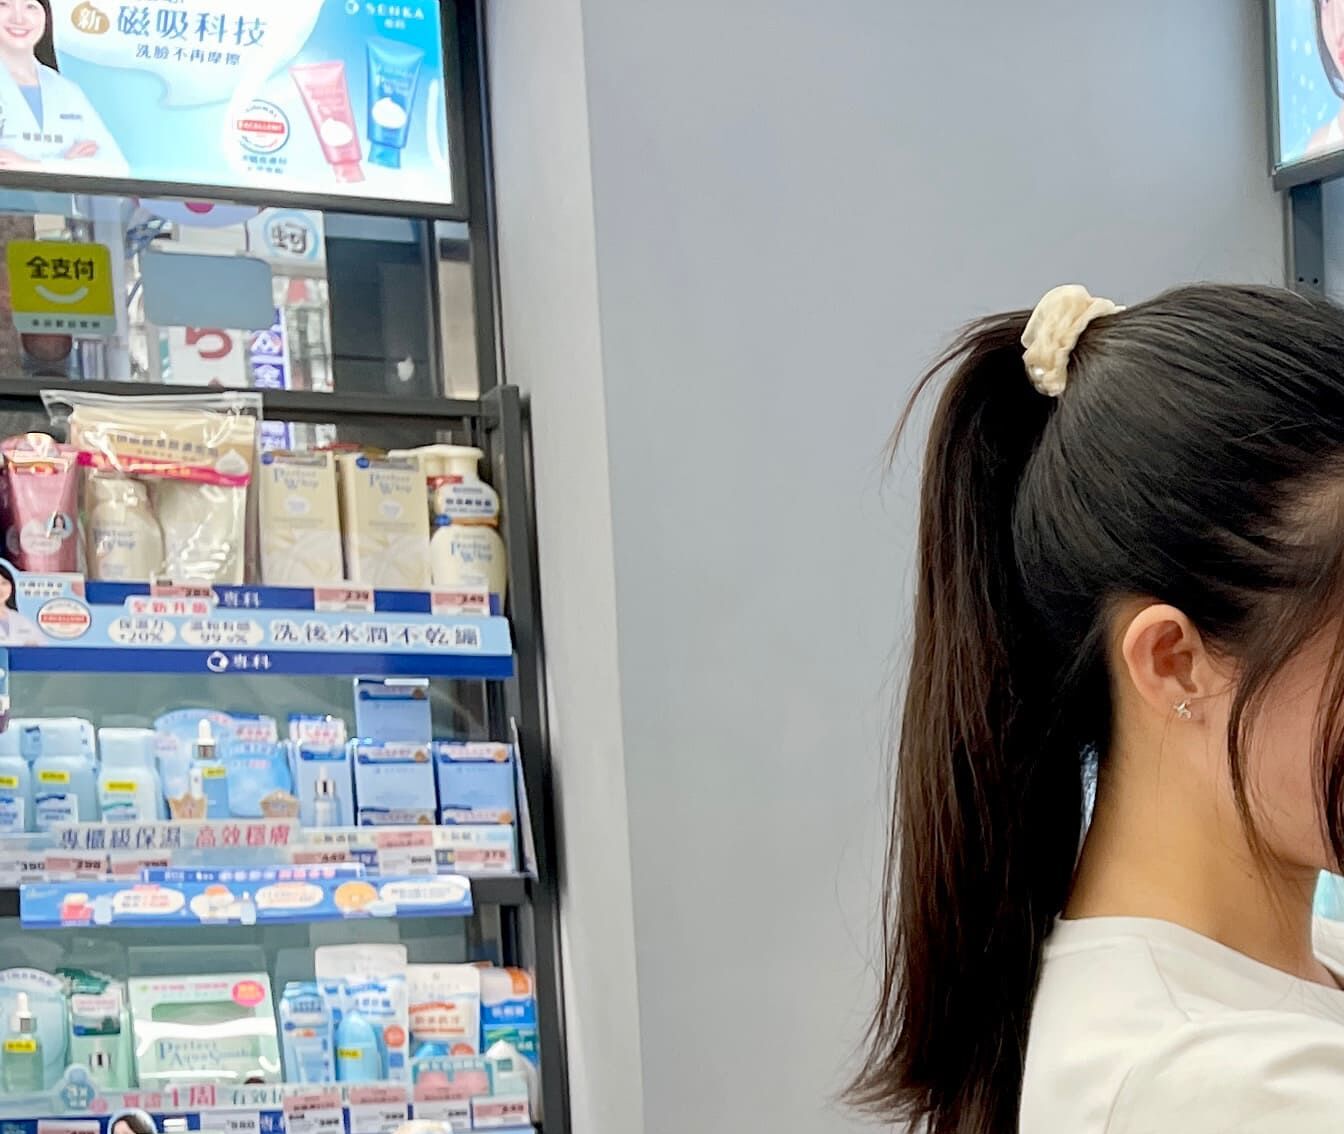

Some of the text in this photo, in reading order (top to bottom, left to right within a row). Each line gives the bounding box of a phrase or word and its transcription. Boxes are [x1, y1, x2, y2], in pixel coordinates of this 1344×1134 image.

[78, 11, 101, 32] 新
[117, 5, 268, 47] 磁吸科技
[136, 43, 241, 66] 洗臉不再摩擦
[26, 255, 95, 281] 全支付
[60, 826, 182, 850] 專櫃級保濕
